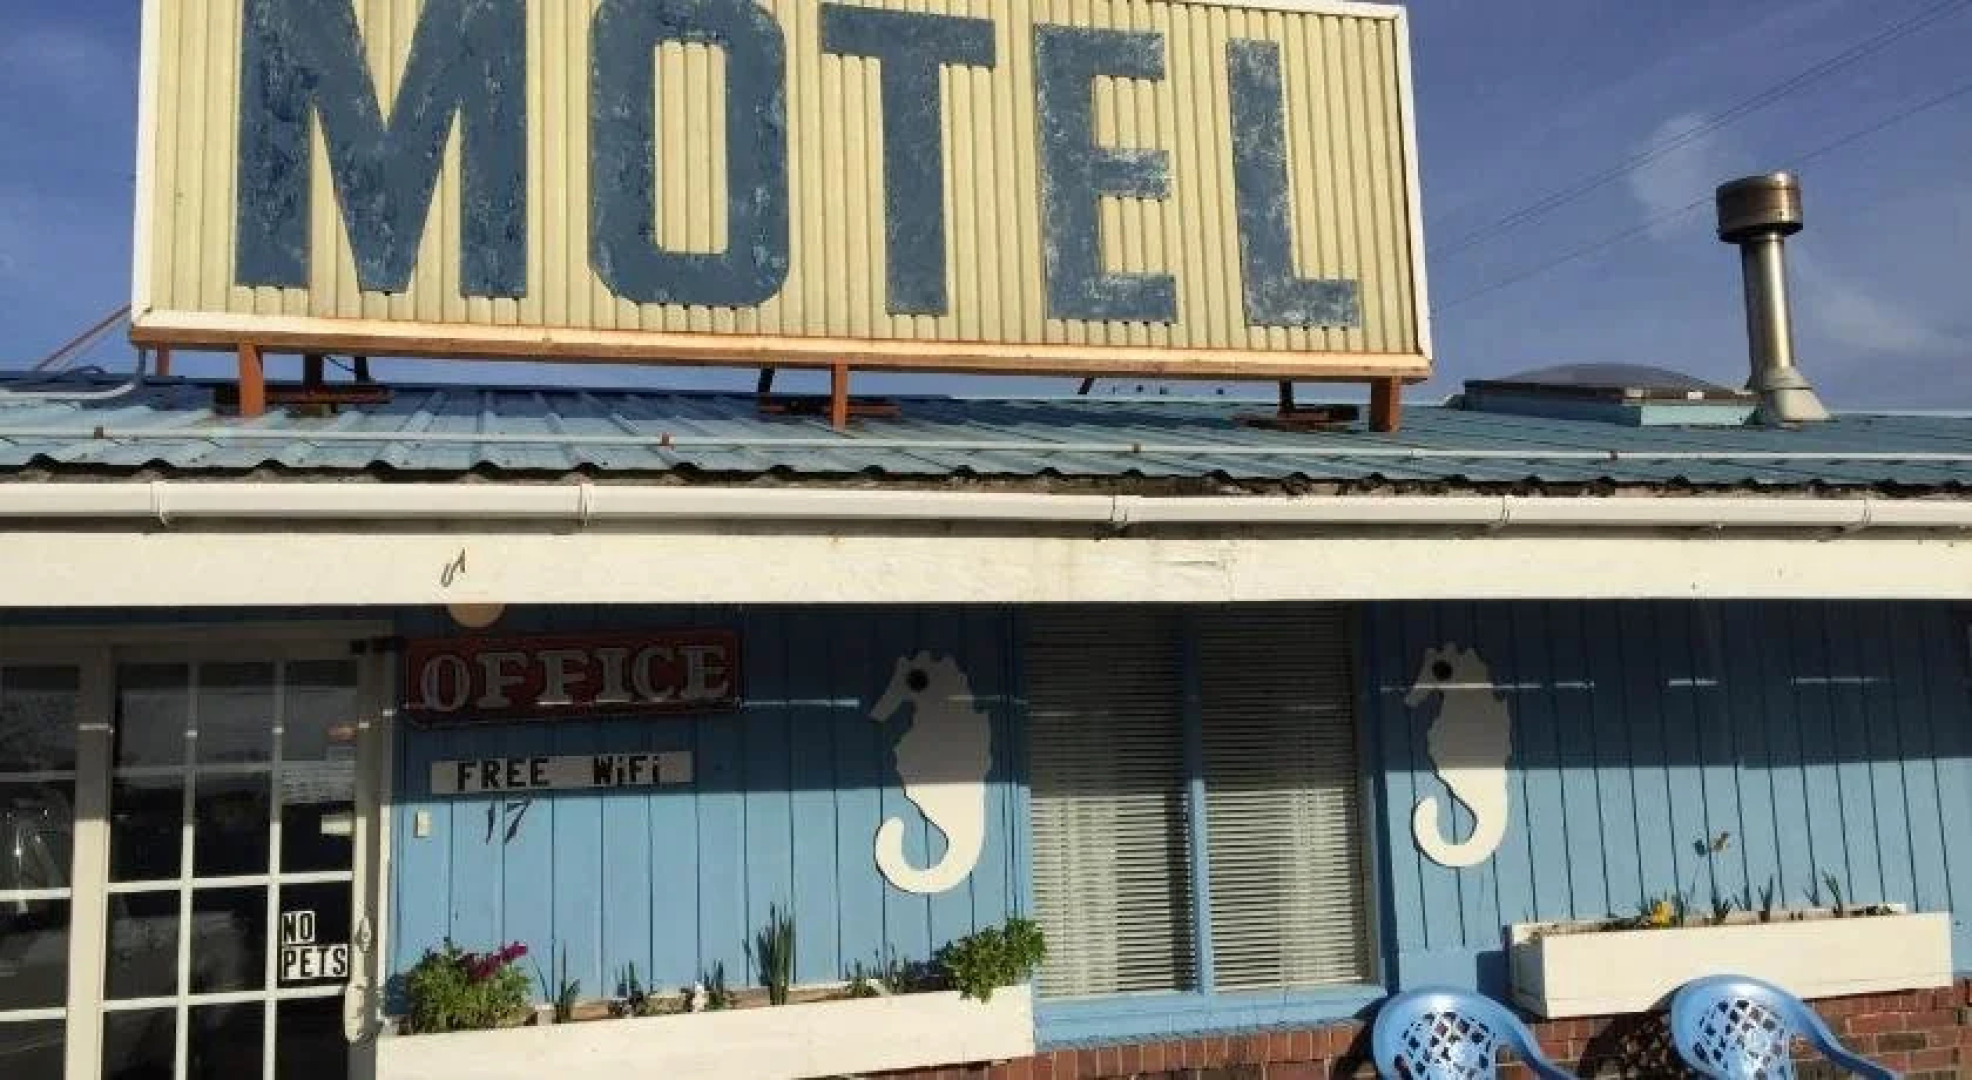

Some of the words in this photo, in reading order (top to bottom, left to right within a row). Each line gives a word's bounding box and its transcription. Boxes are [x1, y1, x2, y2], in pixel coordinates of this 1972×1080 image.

[235, 0, 1361, 328] MOTEL
[420, 646, 729, 712] OFFICE
[456, 757, 551, 791] FREE
[593, 755, 661, 786] WiFi
[283, 912, 313, 943] NO
[283, 947, 346, 978] PETS
